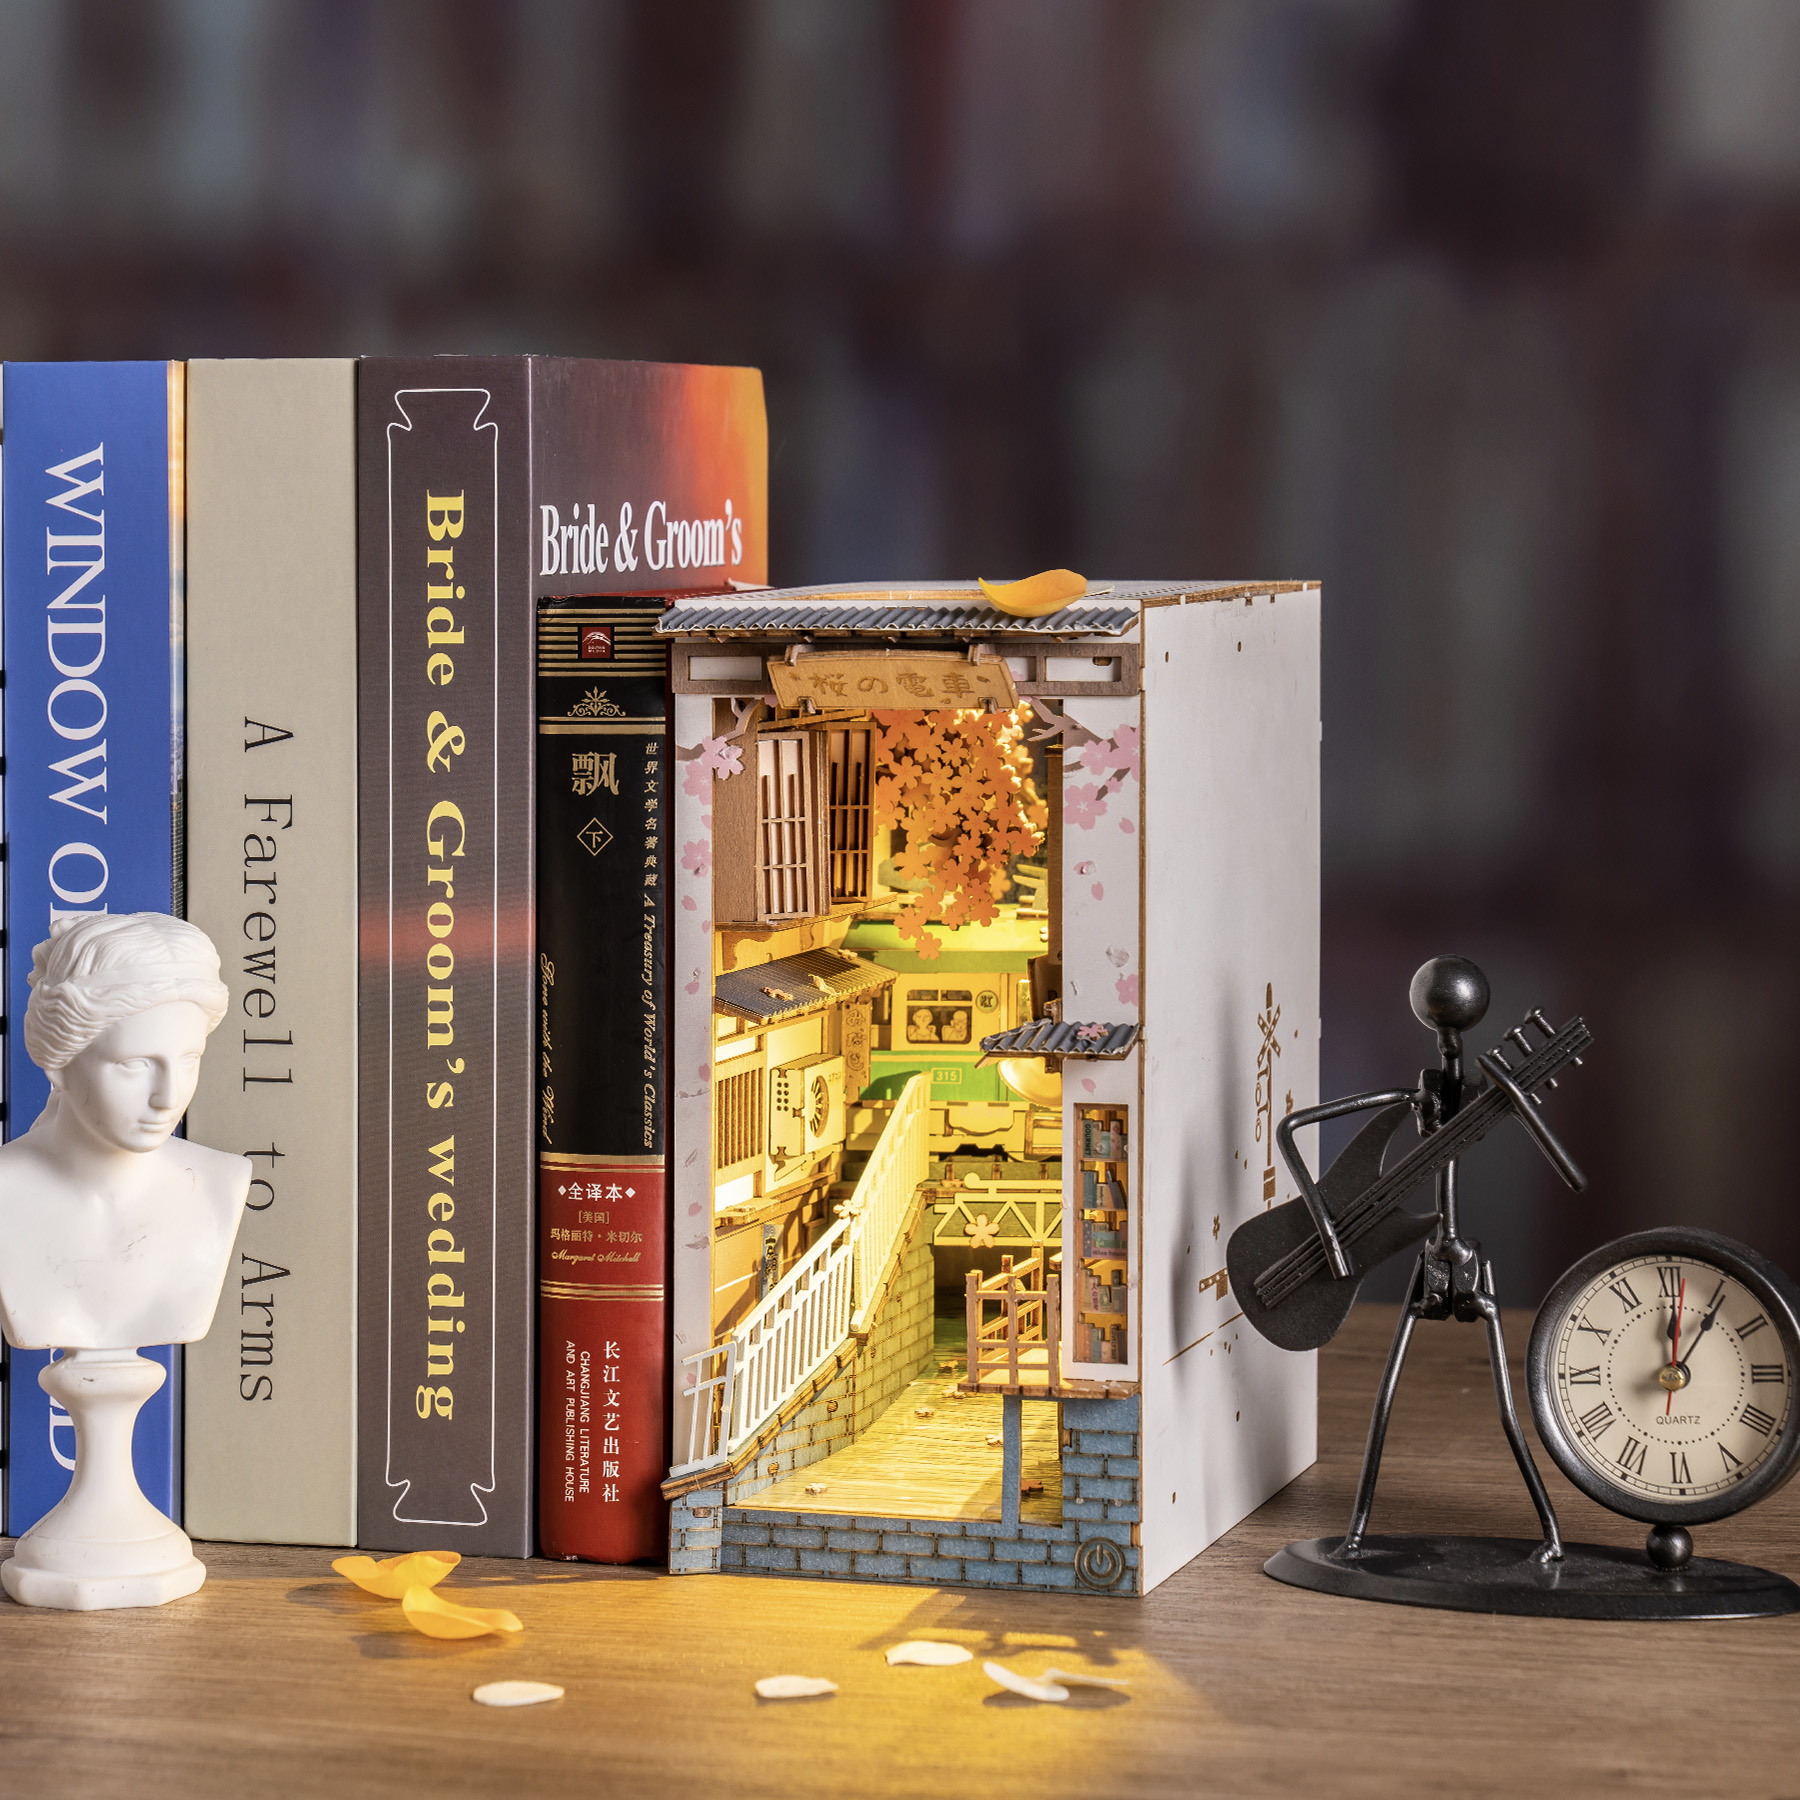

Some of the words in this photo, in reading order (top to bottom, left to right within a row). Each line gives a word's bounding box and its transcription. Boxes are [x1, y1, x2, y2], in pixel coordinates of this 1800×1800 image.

[539, 502, 609, 576] Bride
[614, 501, 638, 573] &
[644, 498, 743, 571] Groom's
[426, 490, 465, 686] Bride
[45, 442, 108, 824] WINDOW
[809, 671, 975, 697] 桜の電車
[244, 716, 294, 753] A
[426, 711, 465, 773] &
[571, 752, 620, 796] 飘
[643, 742, 659, 886] 世界文学名著典藏
[585, 831, 603, 848] 下
[48, 843, 109, 924] O
[644, 893, 656, 907] A
[242, 794, 294, 1092] Farewell
[426, 801, 465, 1109] Groom's
[641, 913, 656, 986] Treasury
[541, 953, 555, 1006] Gone
[641, 989, 656, 1011] of
[542, 1009, 553, 1050] with
[542, 1051, 553, 1077] the
[936, 1071, 957, 1081] 315
[542, 1085, 554, 1145] Wind
[643, 1083, 656, 1149] Classics
[243, 1142, 286, 1212] to
[568, 1182, 623, 1202] 全译本
[578, 1210, 610, 1224] [美国]
[551, 1249, 596, 1265] Margaret
[597, 1251, 642, 1263] Mitchell
[416, 1135, 465, 1420] wedding
[1609, 1277, 1643, 1314] XI
[240, 1253, 292, 1402] Arms
[1577, 1315, 1612, 1346] X
[1735, 1313, 1769, 1341] II
[565, 1340, 576, 1364] AND
[565, 1369, 576, 1392] ART
[580, 1351, 591, 1423] CHANGJIANG
[1569, 1365, 1600, 1386] IX
[1750, 1363, 1784, 1384] III
[565, 1397, 576, 1461] PUBLISHING
[602, 1340, 620, 1502] 长江文艺出版社
[1655, 1415, 1701, 1425] QUARTZ
[579, 1428, 590, 1494] LITERATURE
[1669, 1451, 1693, 1484] VI
[1717, 1442, 1743, 1473] V
[564, 1466, 575, 1502] HOUSE
